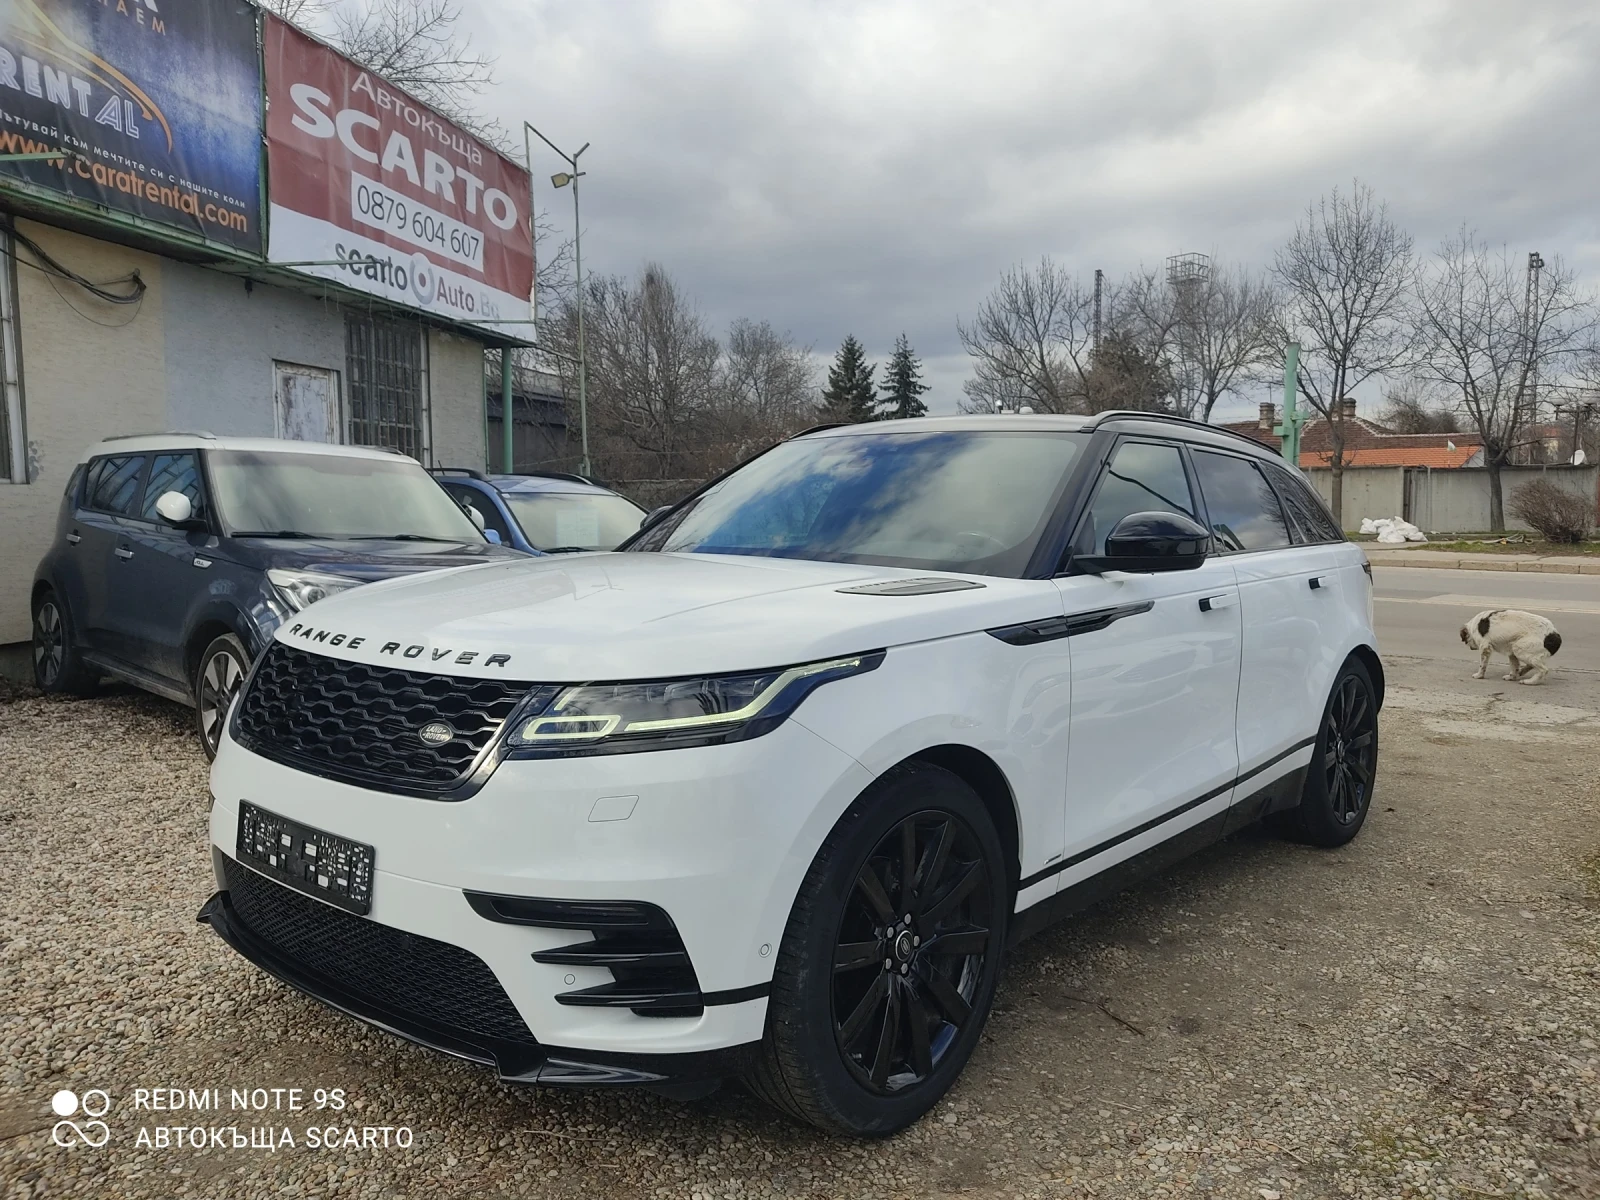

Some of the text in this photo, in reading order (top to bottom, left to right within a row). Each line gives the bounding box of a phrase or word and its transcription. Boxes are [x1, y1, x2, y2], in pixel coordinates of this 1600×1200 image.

[0, 108, 246, 208] ътувай към мечтите си с нашите коли
[289, 83, 518, 230] SCARTO
[351, 72, 483, 166] Автокъща
[357, 184, 479, 261] 0879 604 607
[334, 242, 408, 291] scarto
[289, 623, 512, 668] RANGE ROVER
